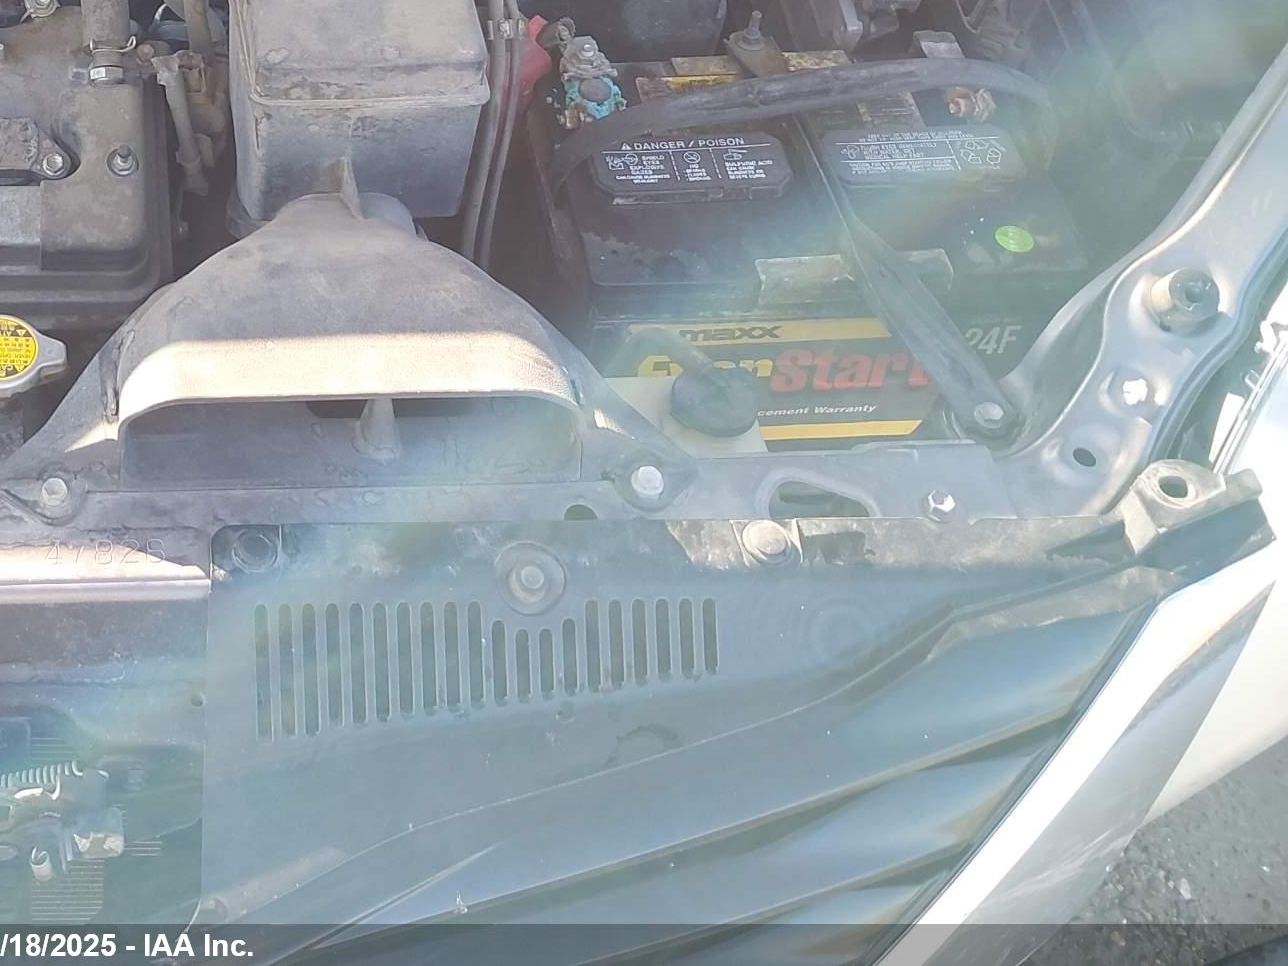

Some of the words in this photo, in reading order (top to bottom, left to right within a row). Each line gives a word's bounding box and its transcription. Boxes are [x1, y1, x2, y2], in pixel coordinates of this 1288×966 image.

[633, 140, 685, 150] DANGER
[698, 137, 745, 147] POISON
[964, 325, 1022, 355] 24F
[814, 404, 877, 414] Warranty
